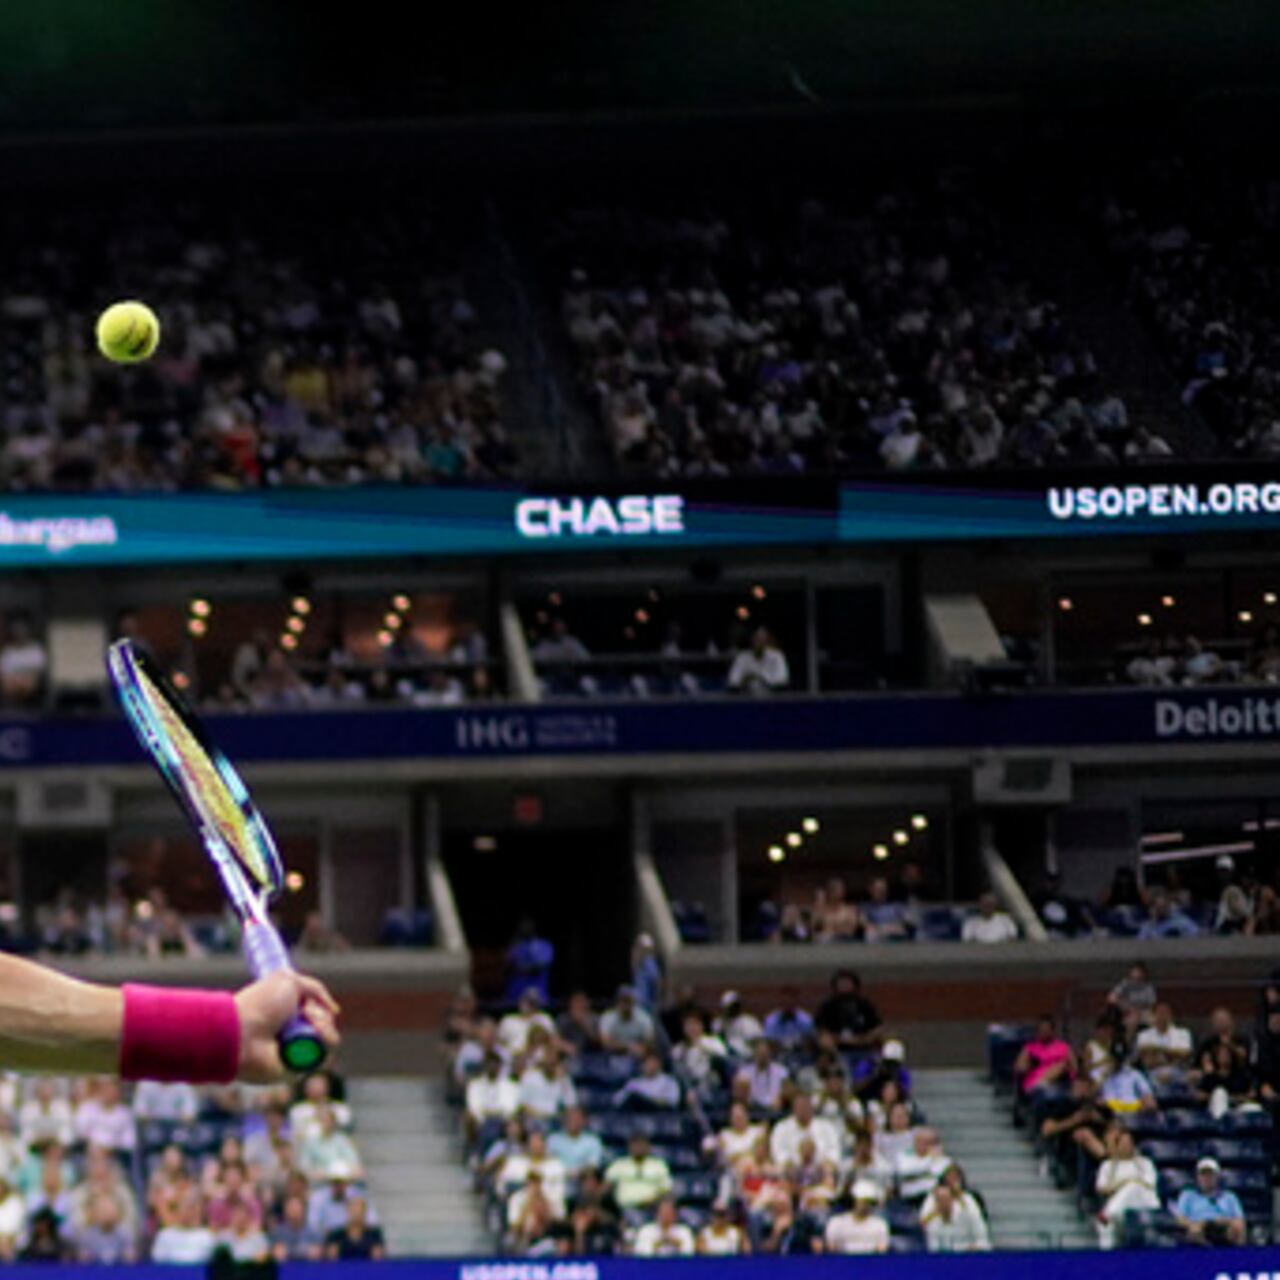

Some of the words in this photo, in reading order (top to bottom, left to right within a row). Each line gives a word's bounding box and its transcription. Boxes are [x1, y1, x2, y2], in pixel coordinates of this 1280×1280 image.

[517, 495, 684, 537] CHASE
[1048, 484, 1280, 518] USOPEN.ORG
[456, 716, 528, 748] IHG
